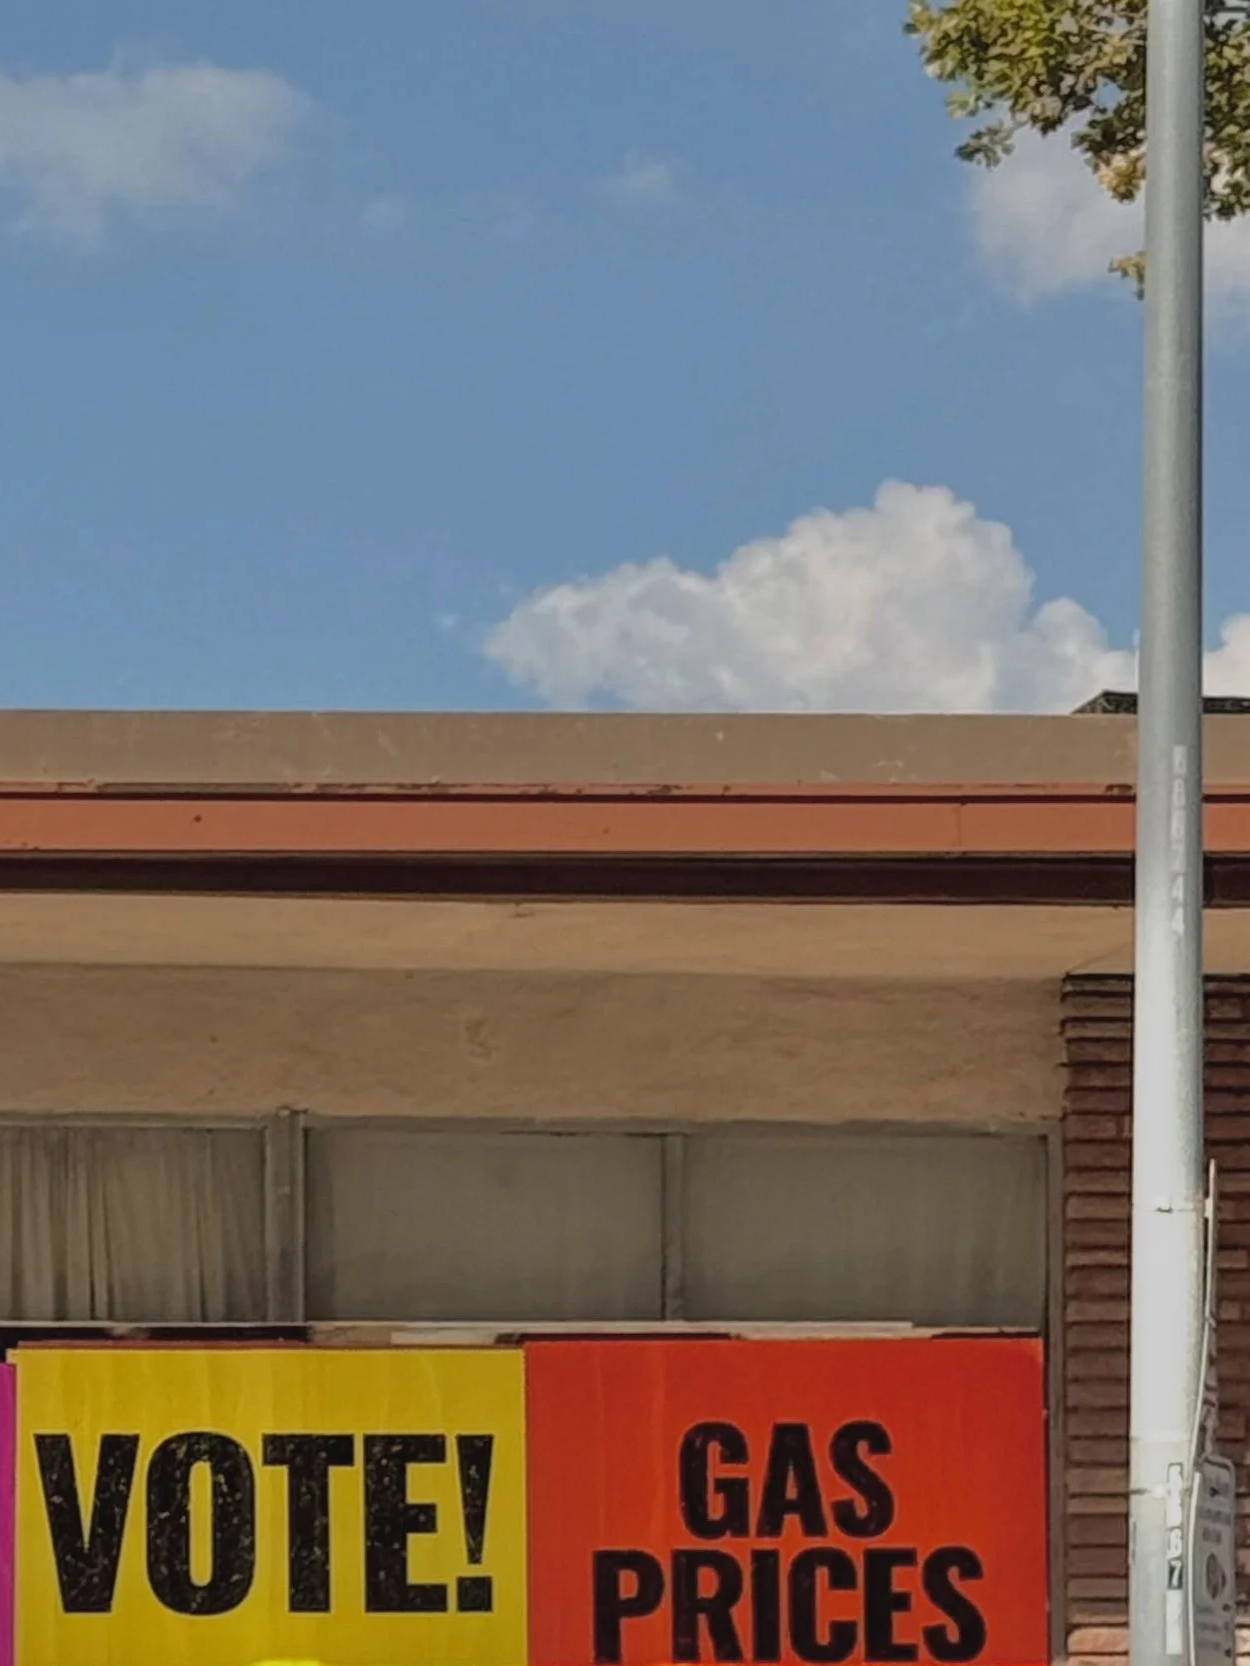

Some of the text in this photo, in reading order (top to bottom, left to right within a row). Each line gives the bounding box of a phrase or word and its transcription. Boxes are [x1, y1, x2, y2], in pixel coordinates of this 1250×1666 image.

[34, 1432, 494, 1615] VOTE!
[678, 1421, 895, 1539] GAS
[592, 1546, 986, 1664] PRICES
